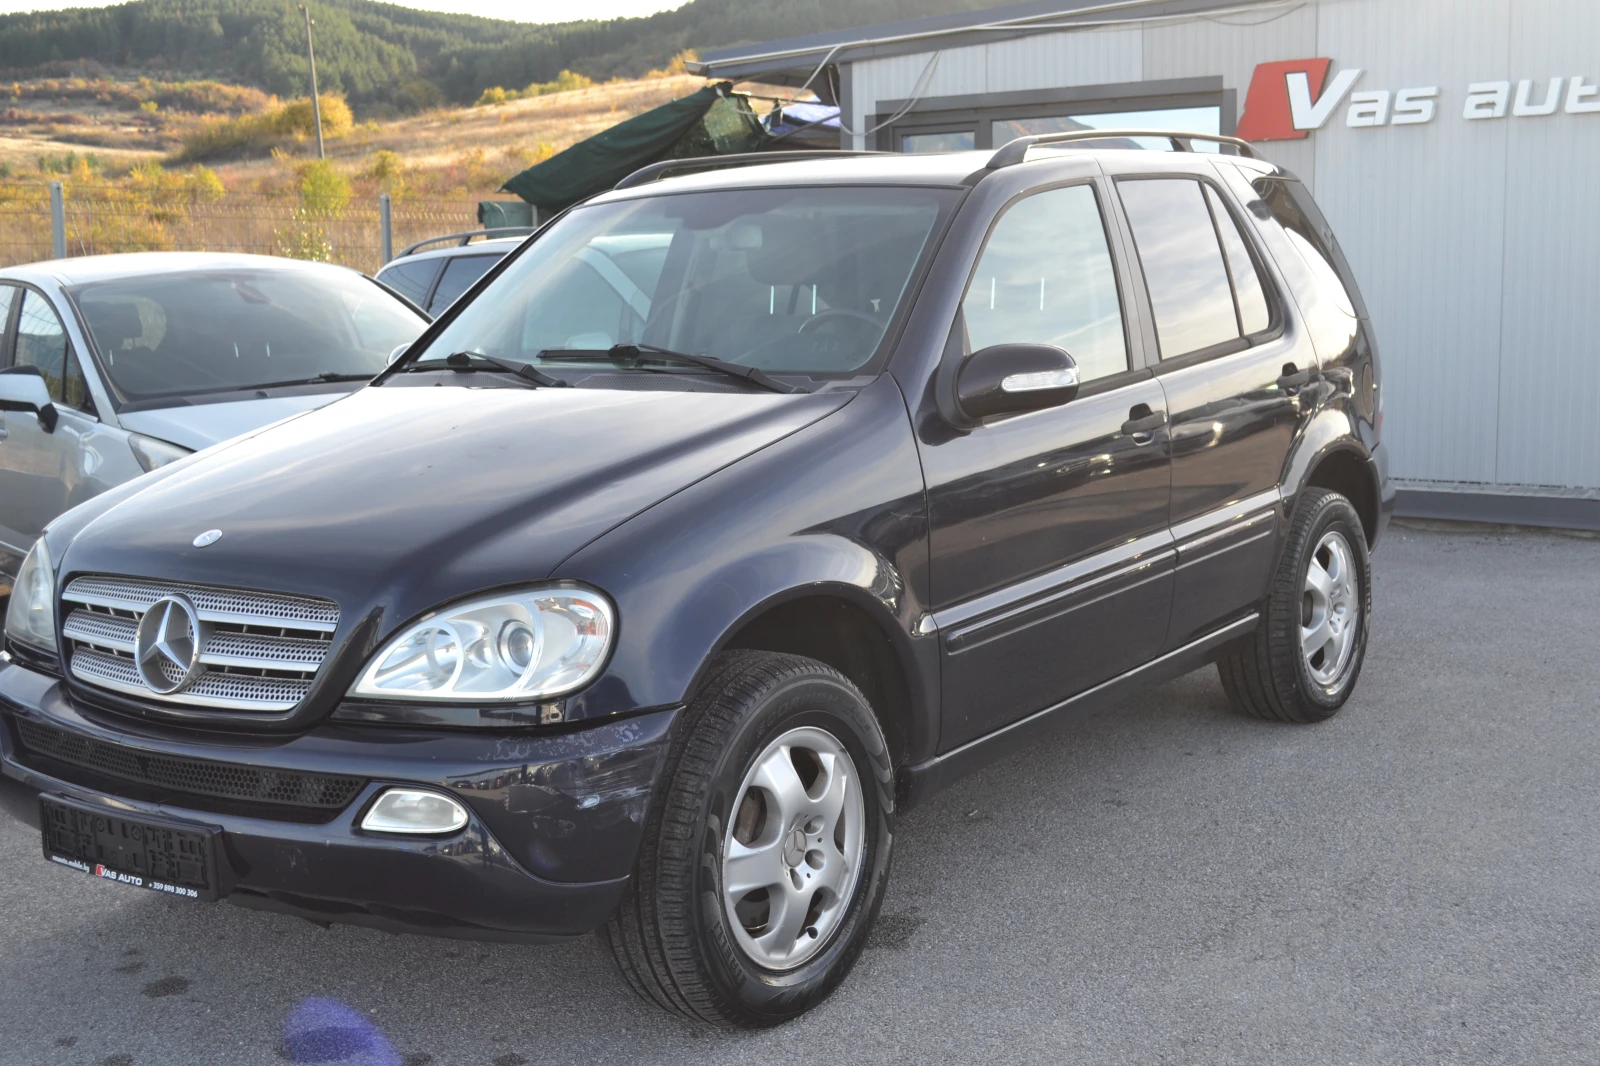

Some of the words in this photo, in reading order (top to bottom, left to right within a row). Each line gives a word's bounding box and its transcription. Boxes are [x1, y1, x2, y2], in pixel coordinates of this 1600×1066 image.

[1284, 68, 1441, 130] Vas
[100, 866, 117, 880] VAS
[118, 873, 142, 886] AUTO
[153, 881, 164, 890] 359
[163, 884, 175, 893] 898
[175, 886, 187, 895] 300
[187, 889, 198, 898] 306
